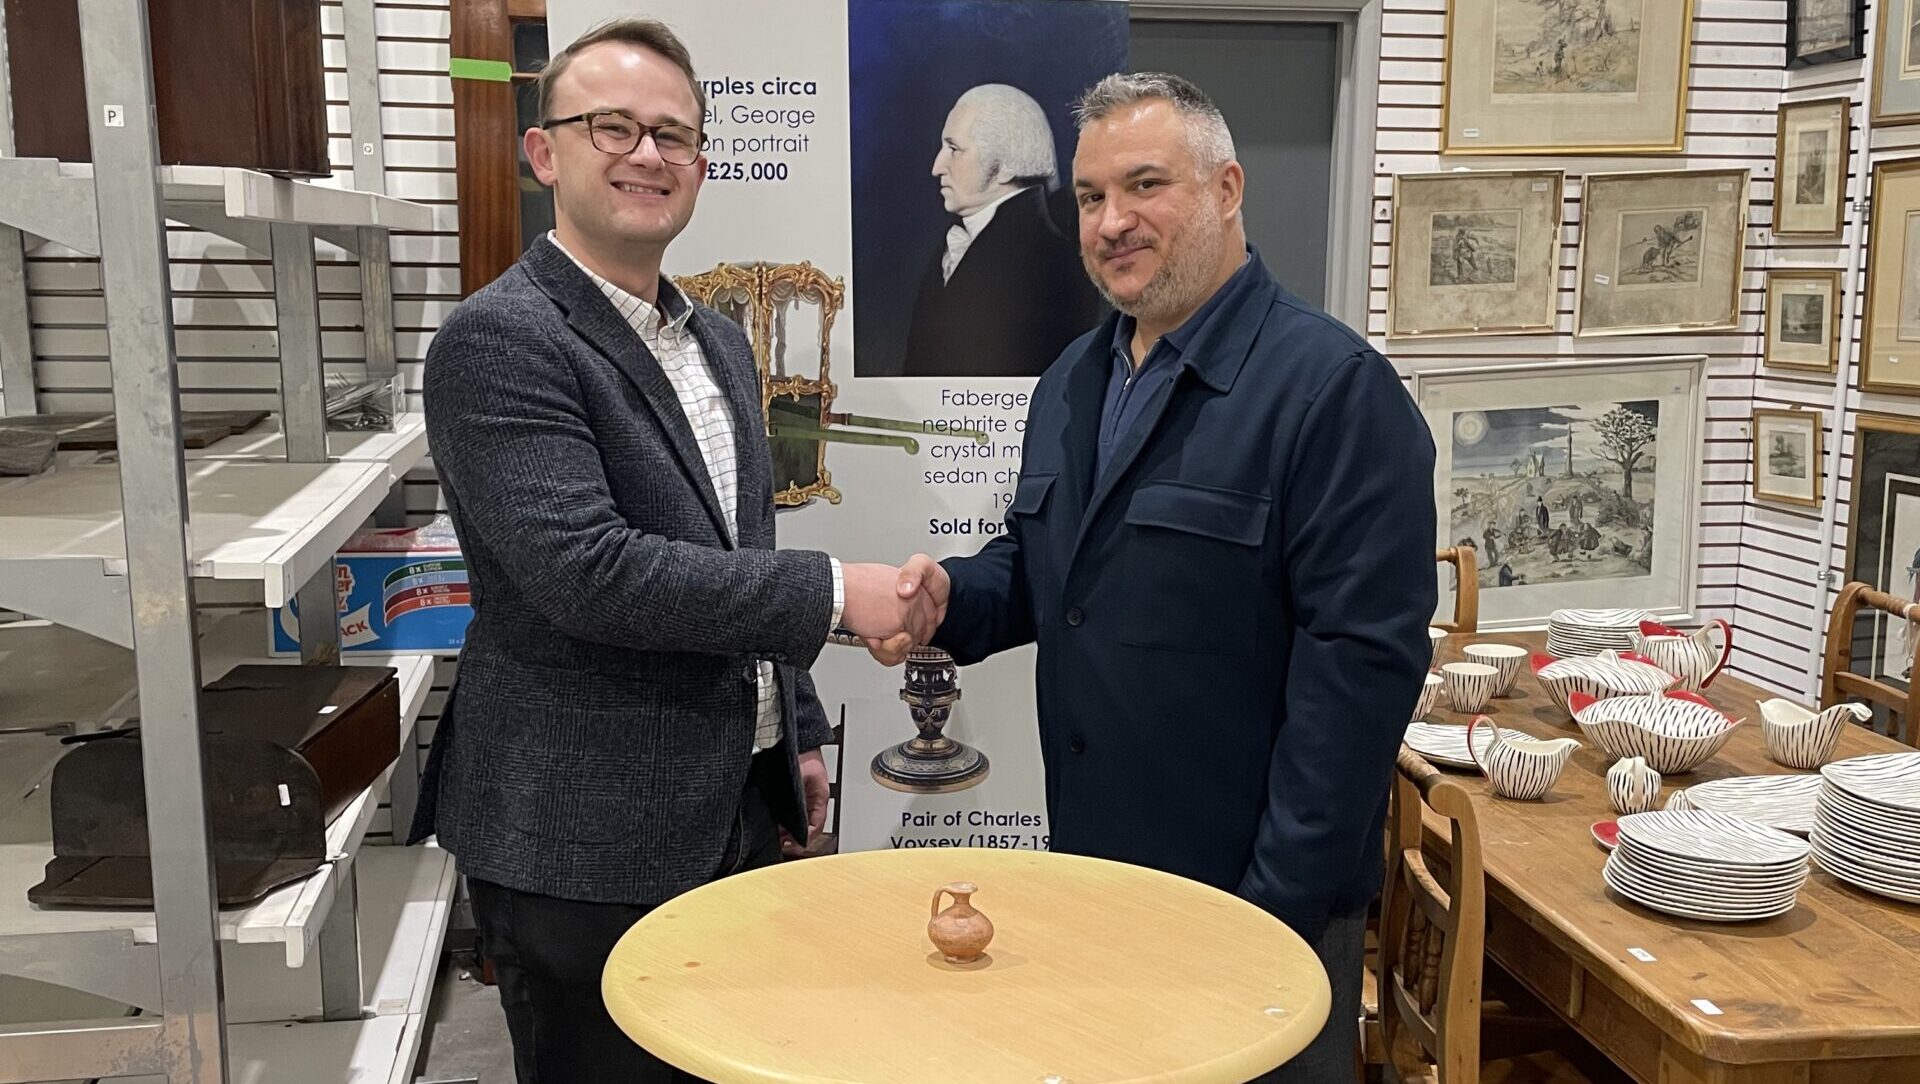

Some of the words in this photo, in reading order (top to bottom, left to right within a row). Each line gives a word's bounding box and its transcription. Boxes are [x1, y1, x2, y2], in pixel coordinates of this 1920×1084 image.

[698, 76, 755, 99] rples
[762, 77, 817, 95] circa
[108, 110, 116, 123] P
[704, 104, 723, 125] el,
[731, 105, 815, 129] George
[701, 138, 725, 152] on
[732, 134, 810, 156] portrait
[707, 162, 788, 182] £25,000
[941, 389, 1028, 410] Faberge
[922, 415, 1007, 436] nephrite
[931, 441, 995, 461] crystal
[1003, 445, 1021, 458] m
[924, 467, 987, 484] sedan
[994, 467, 1019, 484] ch
[993, 493, 1013, 509] 19
[929, 518, 971, 534] Sold
[978, 518, 1004, 534] for
[341, 620, 368, 637] ACK
[902, 811, 937, 827] Pair
[943, 811, 962, 826] of
[968, 811, 1042, 827] Charles
[968, 834, 1050, 850] (1857-19
